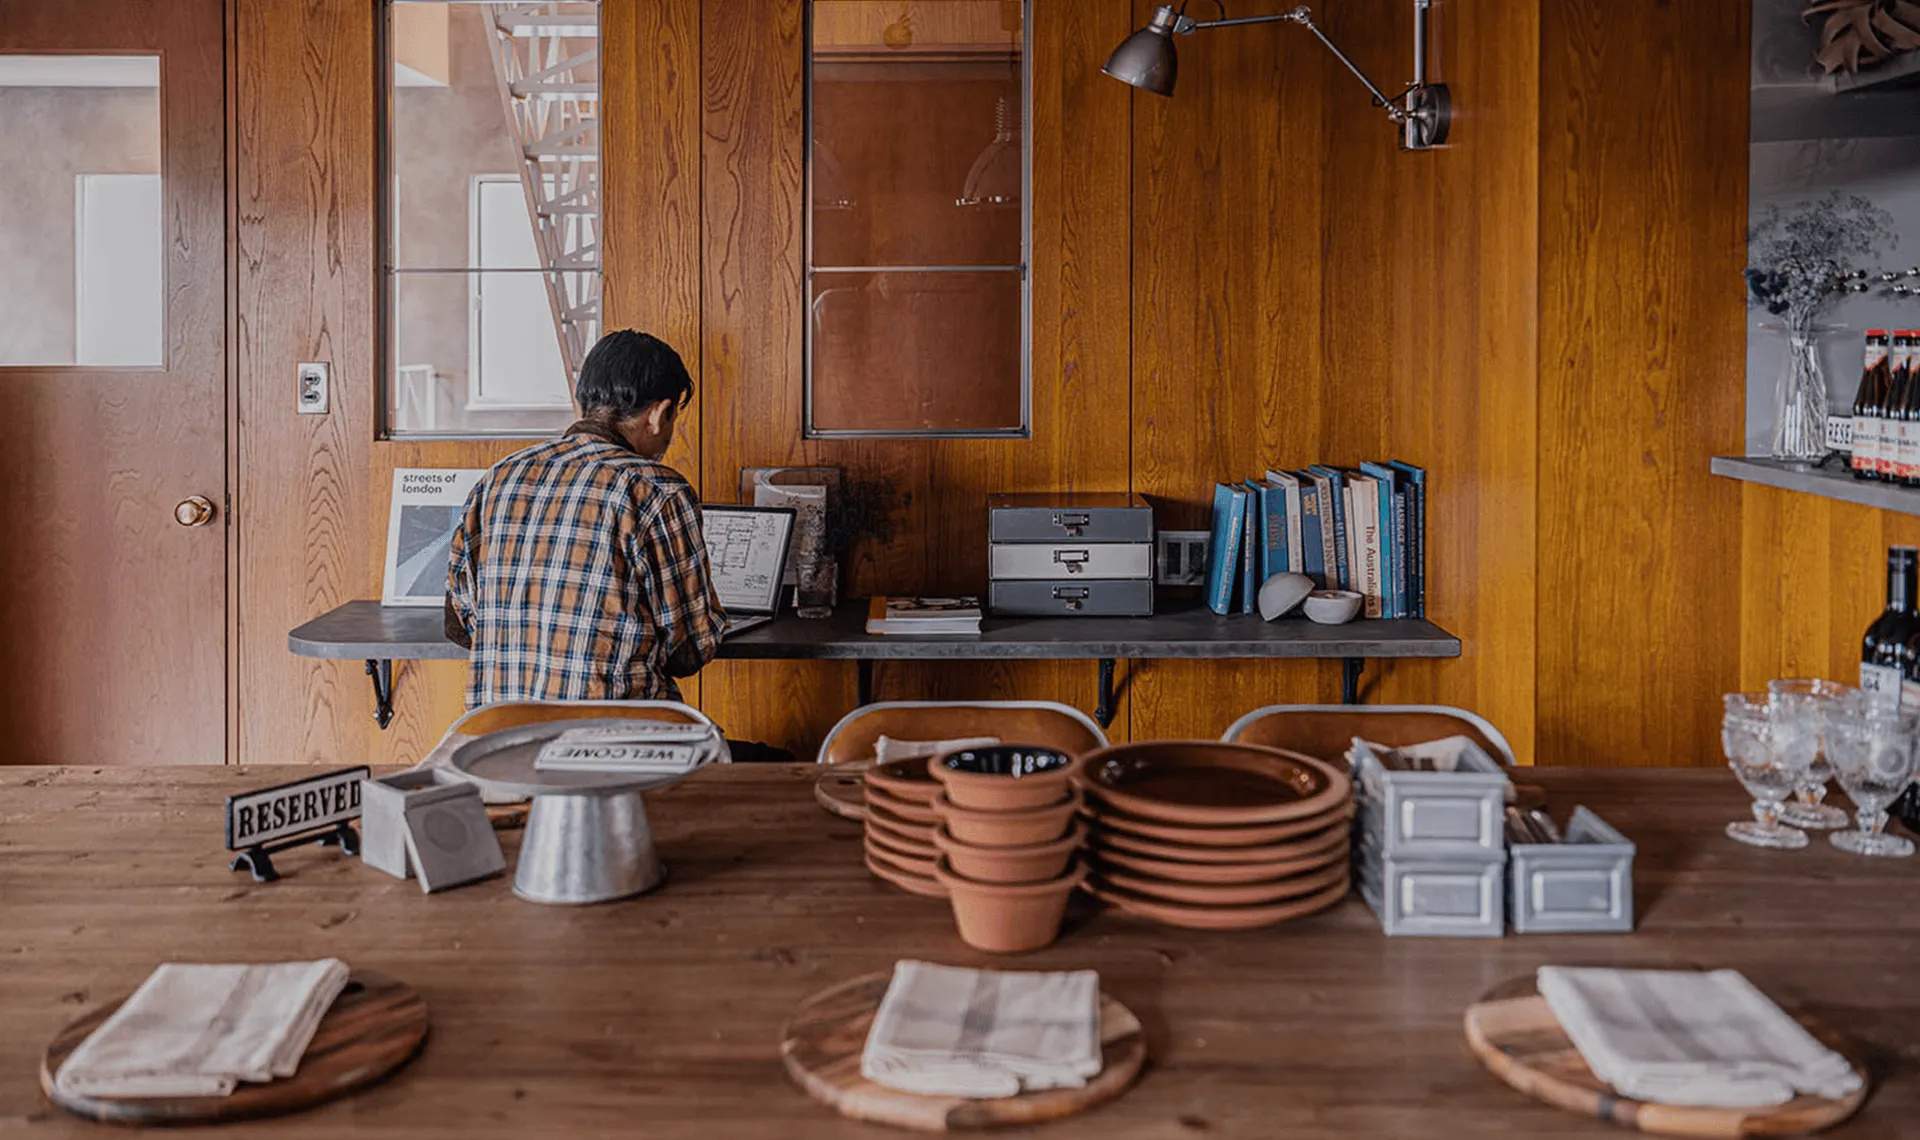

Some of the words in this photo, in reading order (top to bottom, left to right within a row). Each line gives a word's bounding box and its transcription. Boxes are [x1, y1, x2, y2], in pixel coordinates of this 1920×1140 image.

[403, 474, 442, 483] streets
[444, 473, 457, 483] of
[402, 483, 443, 494] london
[1366, 526, 1376, 544] The
[1366, 547, 1377, 607] Australians
[560, 748, 674, 760] WELCOME
[238, 779, 361, 838] RESERVED
